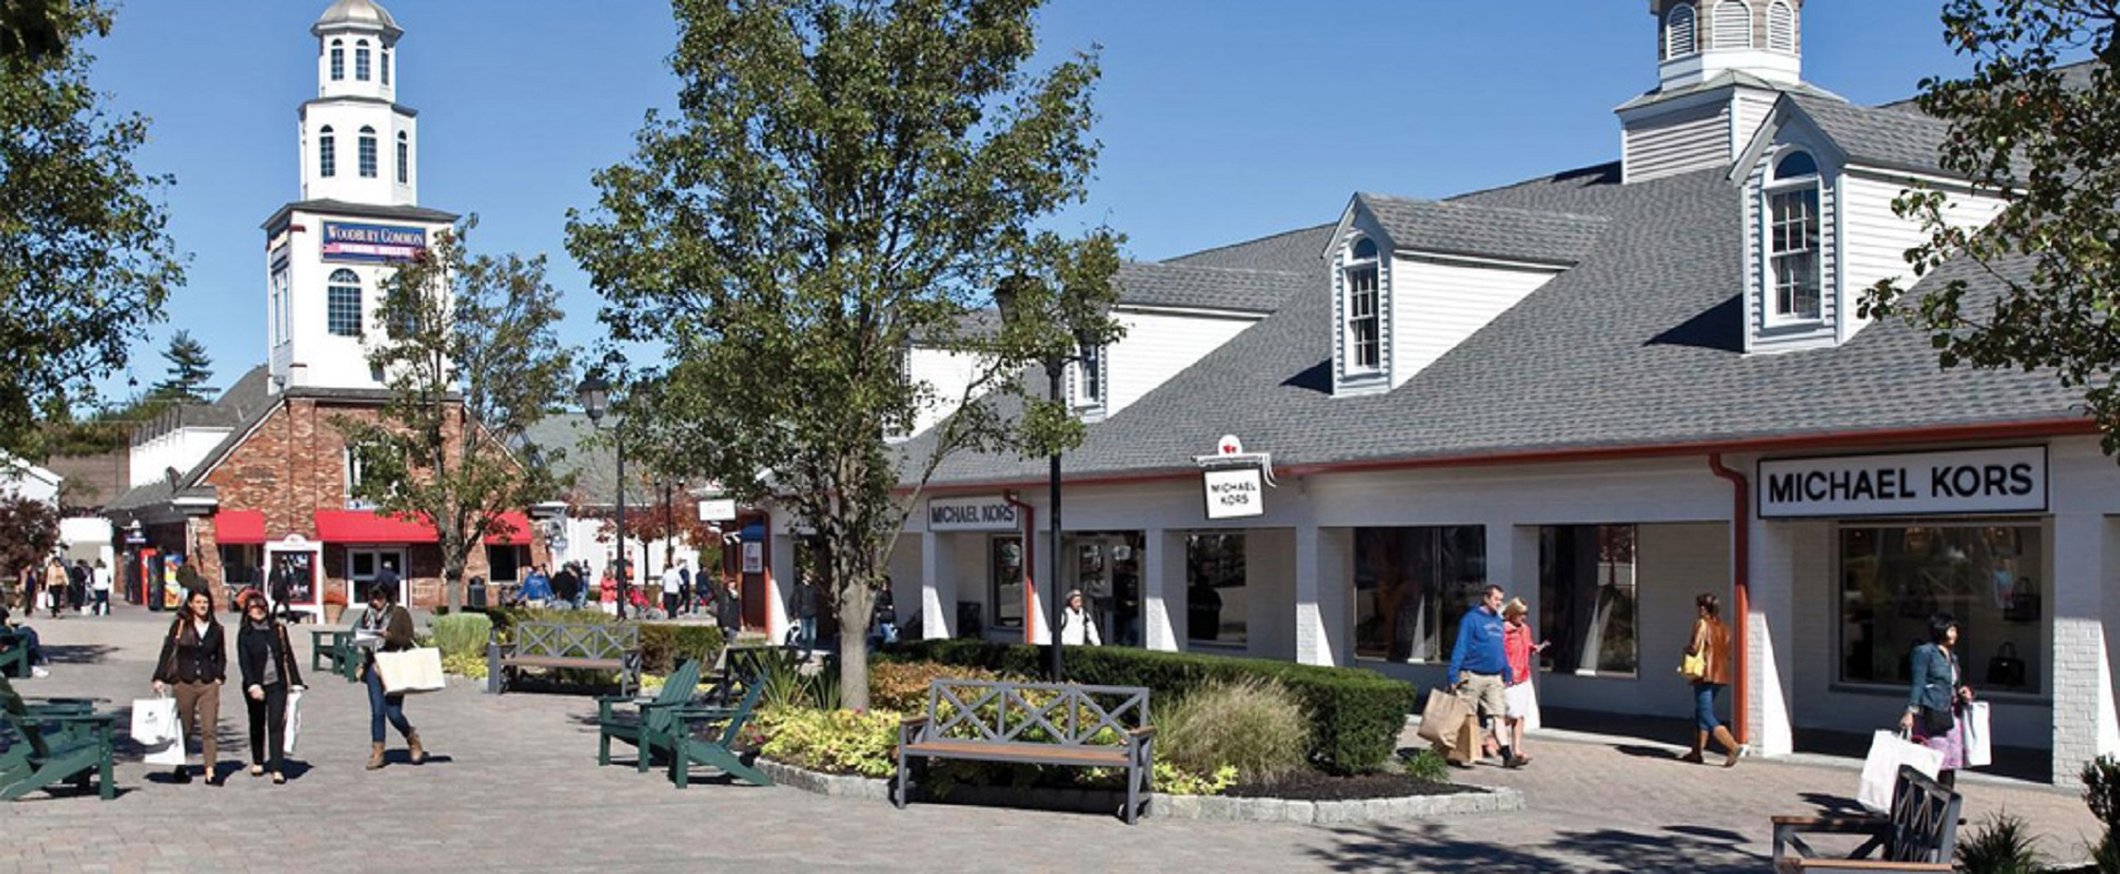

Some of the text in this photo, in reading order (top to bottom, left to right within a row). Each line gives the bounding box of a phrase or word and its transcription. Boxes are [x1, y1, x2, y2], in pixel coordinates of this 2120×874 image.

[326, 224, 424, 245] WOODBURY COMMON
[1210, 481, 1256, 493] MICHAEL
[1768, 463, 2034, 503] MICHAEL KORS
[1220, 493, 1250, 506] KORS
[931, 504, 1015, 523] MICHAEL KORS
